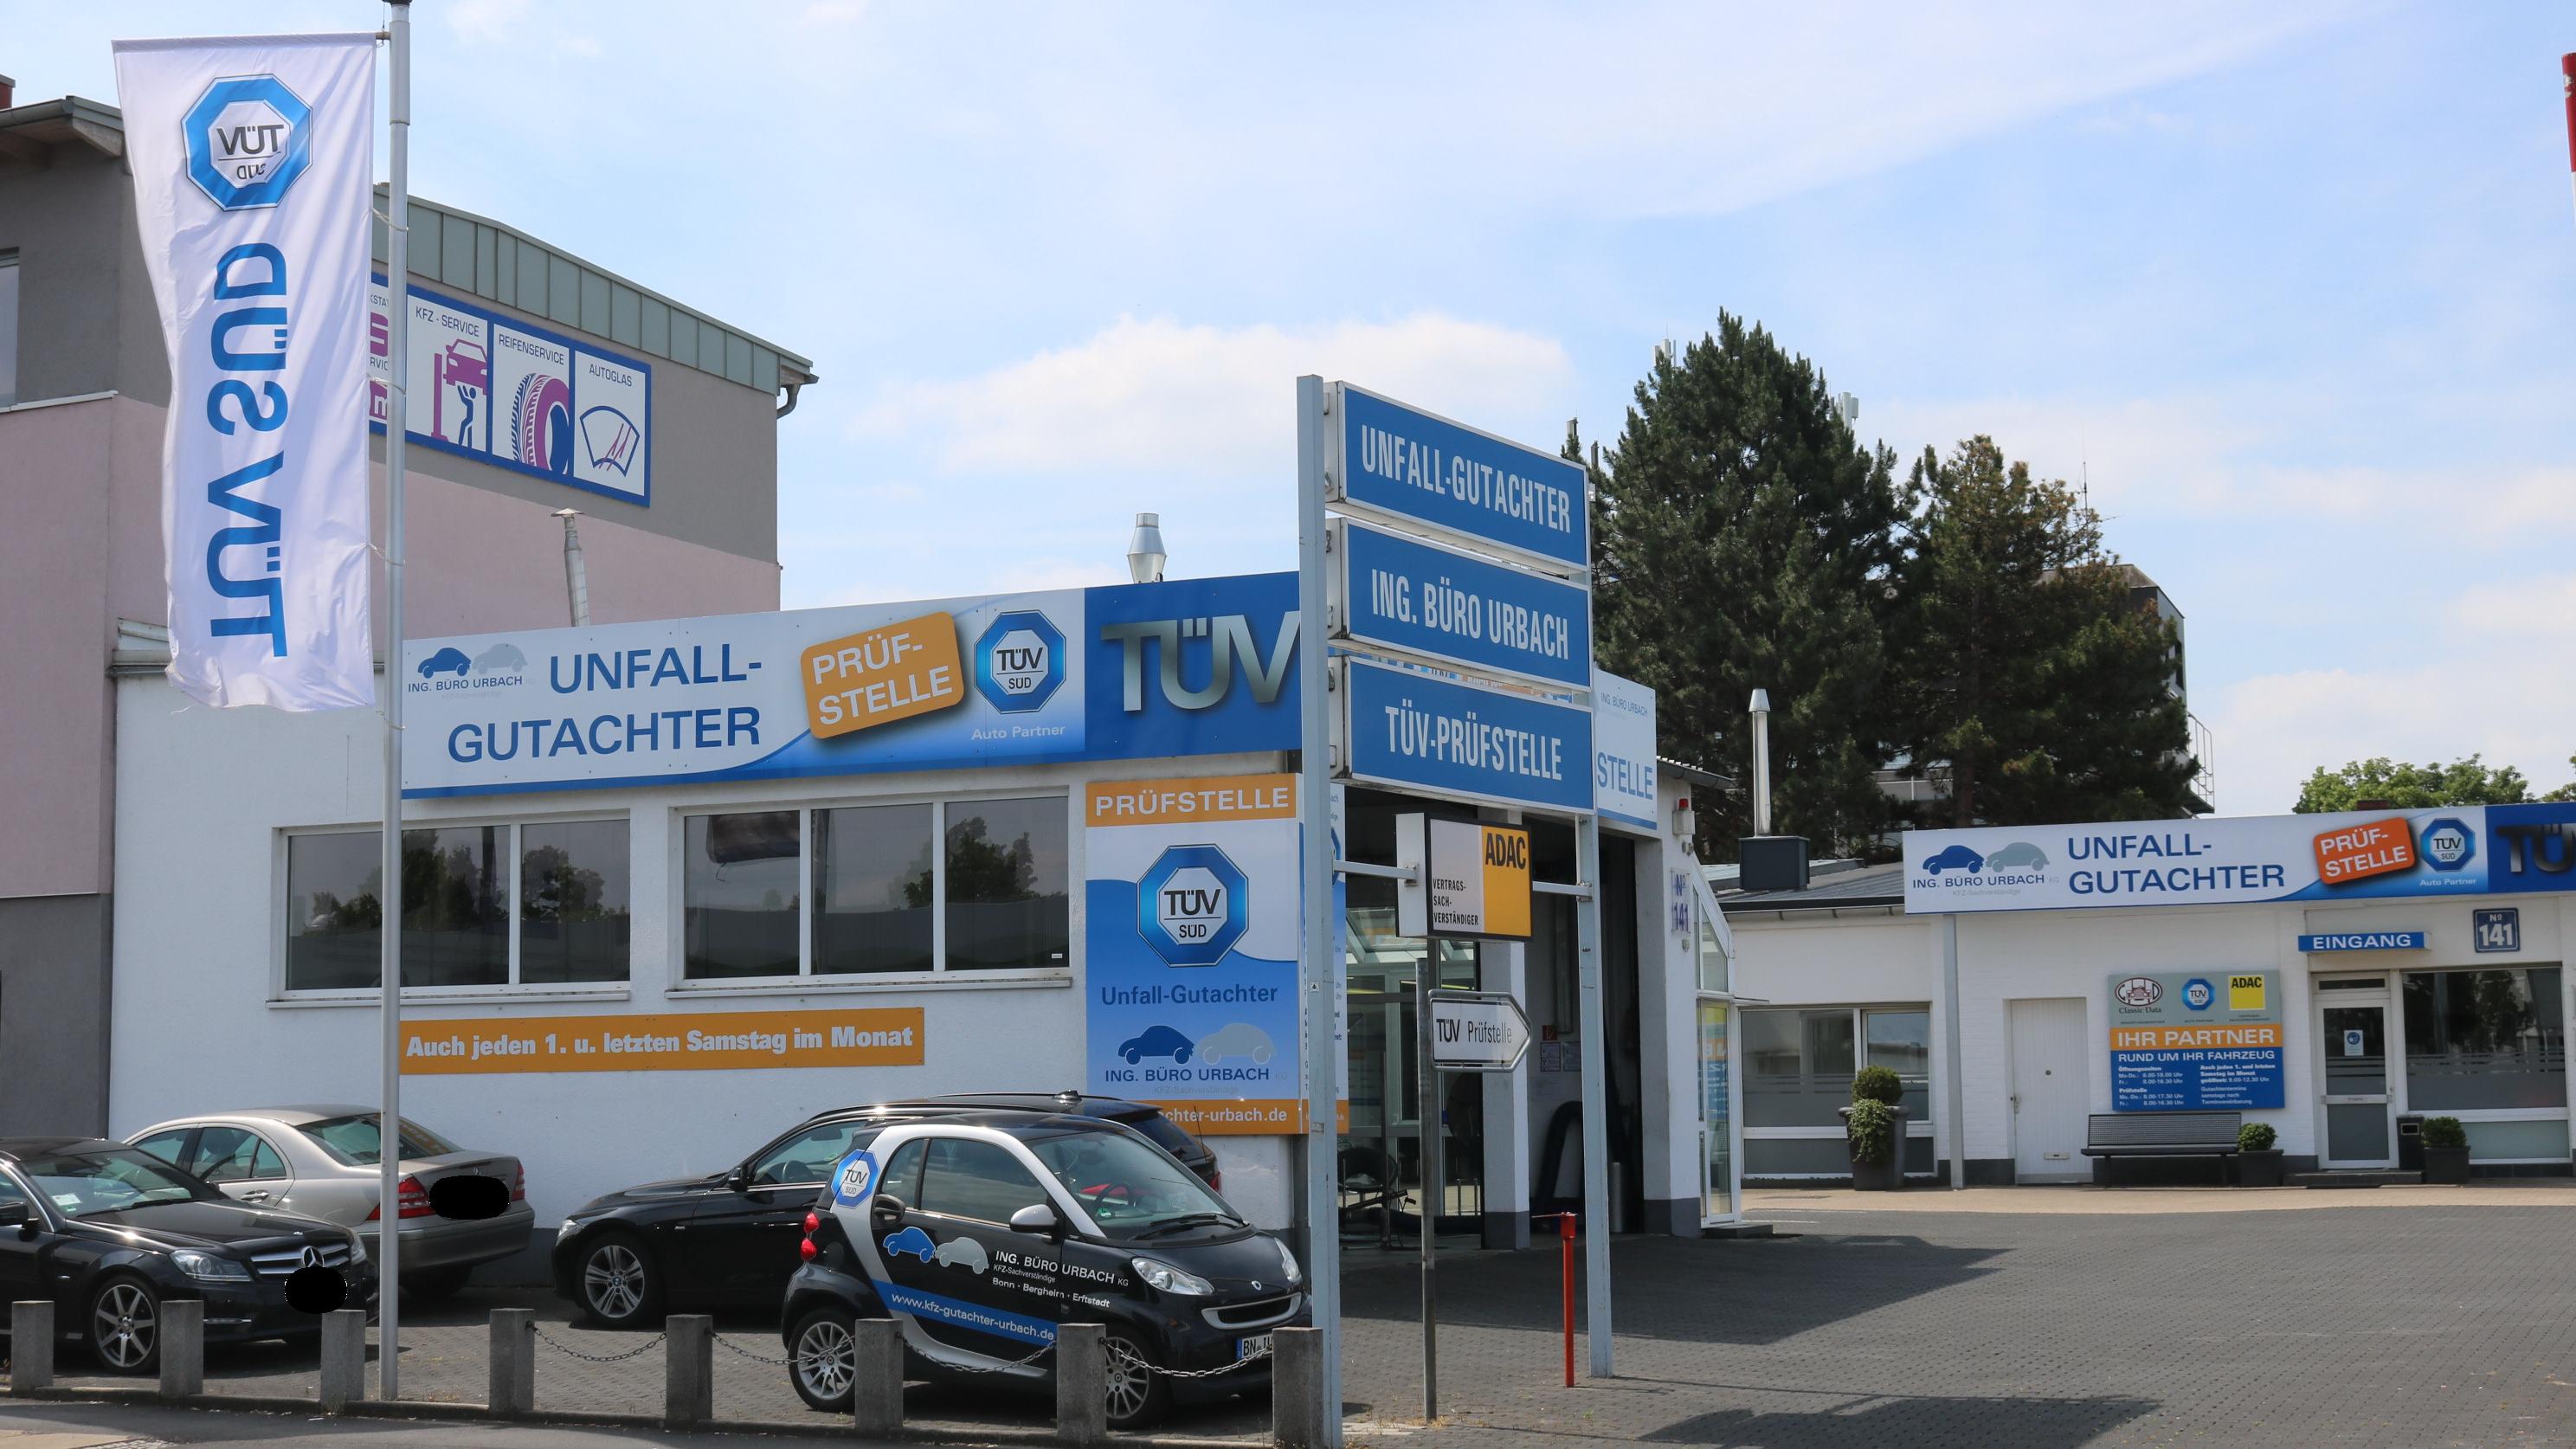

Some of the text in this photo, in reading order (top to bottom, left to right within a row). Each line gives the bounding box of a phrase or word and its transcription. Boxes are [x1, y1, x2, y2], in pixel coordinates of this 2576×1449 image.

[415, 306, 434, 324] KFZ
[441, 311, 480, 338] SERVICE
[499, 334, 564, 365] REIFENSERVICE
[589, 364, 632, 387] AUTOGLAS
[1360, 423, 1572, 535] UNFALL-GUTACHTER
[1371, 569, 1568, 660] ING. BÜRO URBACH
[550, 643, 763, 694] UNFALL-
[812, 632, 924, 686] PRÜF-
[996, 647, 1044, 672] TÜV
[1101, 610, 1301, 712] TÜV
[408, 683, 432, 693] ING.
[435, 679, 469, 691] BÜRO
[473, 676, 523, 688] URBACH
[818, 664, 953, 726] STELLE
[1008, 675, 1033, 690] SÜD
[448, 706, 762, 763] GUTACHTER
[971, 724, 1066, 741] Auto Partner
[1385, 699, 1563, 782] TÜV-PRÜFSTELLE
[1597, 751, 1653, 801] STELLE
[1096, 787, 1290, 818] PRÜFSTELLE
[1485, 832, 1527, 870] ADAC
[2068, 834, 2212, 860] UNFALL-
[2321, 828, 2389, 856] PRÜF-
[2434, 837, 2461, 851] TÜV
[2496, 823, 2576, 873] TÜ
[2325, 846, 2408, 878] STELLE
[1433, 878, 1466, 892] VERTRAGS-
[1913, 879, 1940, 889] ING.
[1945, 875, 1983, 888] BÜRO
[1987, 874, 2045, 886] URBACH
[2069, 864, 2285, 895] GUTACHTER
[2444, 878, 2478, 886] Partner
[1164, 889, 1221, 916] TÜV
[1433, 895, 1452, 908] SACH-
[1433, 909, 1479, 926] VERSTÄNDIGER
[1674, 902, 1689, 932] 141
[1178, 924, 1208, 939] SÜD
[2312, 933, 2412, 950] EINGANG
[2479, 924, 2513, 946] 141
[1101, 984, 1278, 1007] Unfall-Gutachter
[2231, 976, 2262, 989] ADAC
[406, 1026, 913, 1061] Auch jeden 1. u. letzten Samstag im Monat
[1436, 1018, 1512, 1044] TÜV Prüfstelle
[2118, 1028, 2275, 1046] IHR PARTNER
[2118, 1050, 2276, 1062] RUND UM IHR FAHRZEUG
[1104, 1069, 1139, 1083] ING.
[1144, 1066, 1193, 1082] BÜRO
[1198, 1067, 1270, 1082] URBACH
[993, 1264, 1056, 1284] KFZ-Sachverständige
[995, 1250, 1129, 1286] ING. BÜRO URBACH KG
[992, 1277, 1015, 1289] Bonn
[1072, 1292, 1111, 1309] Erftstadt
[892, 1293, 1054, 1341] www.kfz-gutachter-urbach.de
